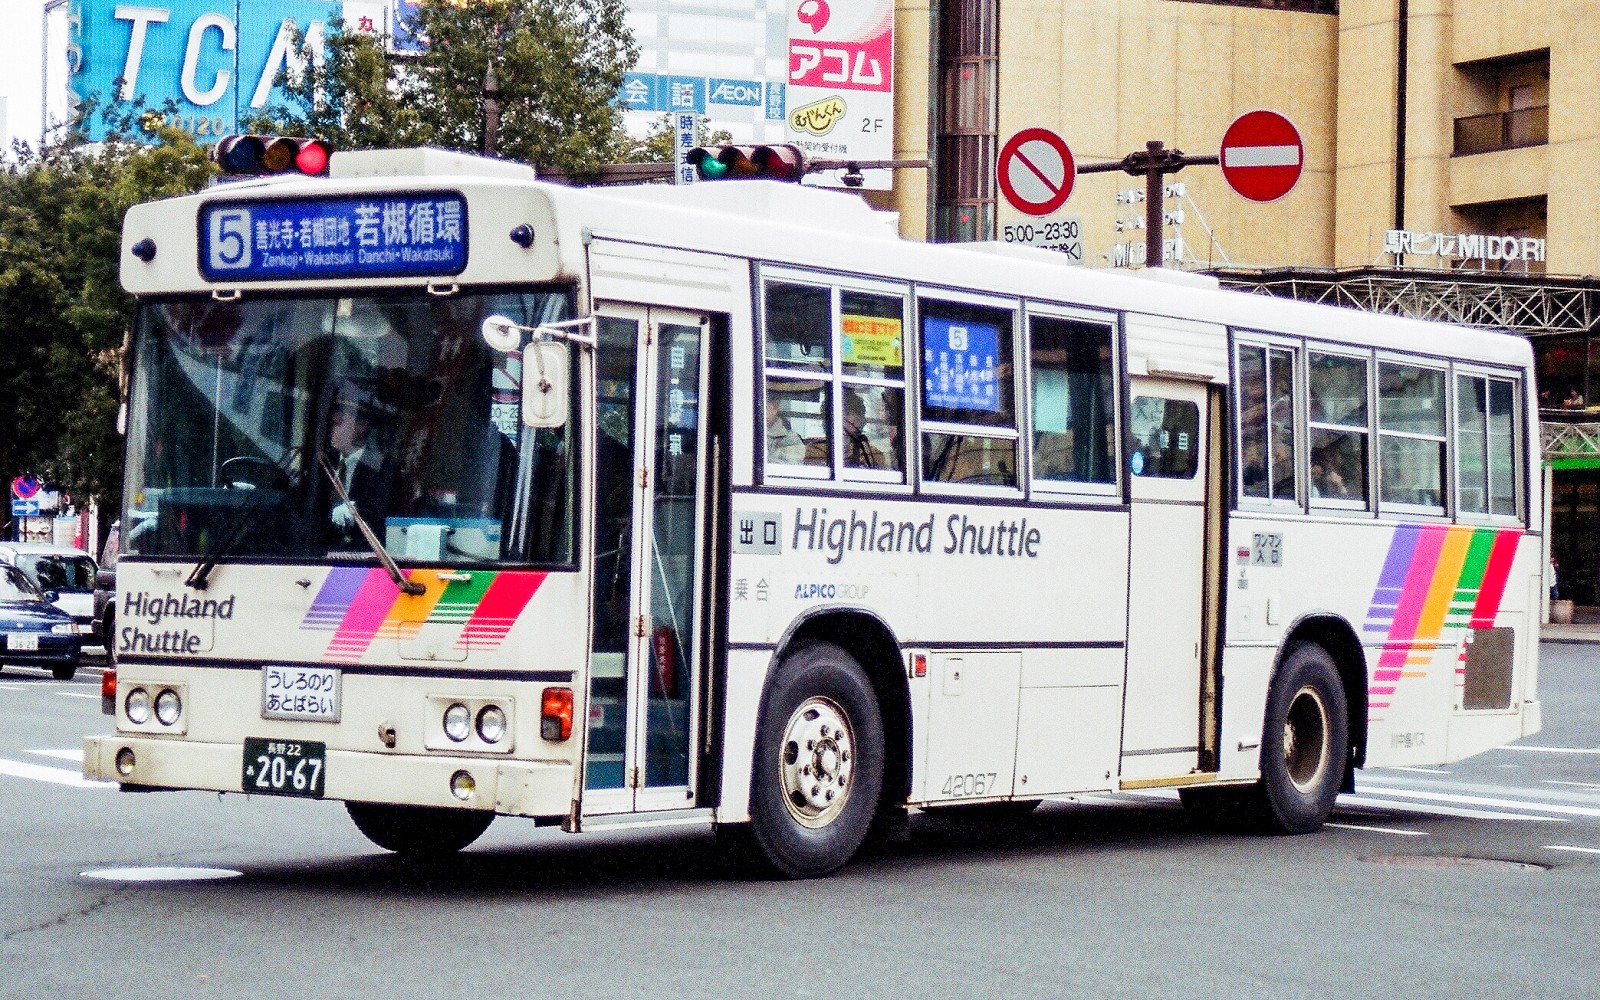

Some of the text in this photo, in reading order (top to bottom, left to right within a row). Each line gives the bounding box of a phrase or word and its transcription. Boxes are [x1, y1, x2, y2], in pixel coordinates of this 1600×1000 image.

[790, 46, 882, 85] アコム
[625, 79, 694, 107] 会話
[794, 101, 842, 130] むじんくん
[861, 117, 884, 133] 2F
[354, 200, 461, 248] 若槻循環
[218, 214, 245, 265] 5
[1458, 233, 1545, 262] MIDORI
[740, 519, 776, 545] 出口
[792, 507, 1041, 564] Highland Shuttle
[123, 592, 236, 625] Highland
[119, 626, 200, 654] Shuttle
[268, 671, 333, 692] うしろのり
[267, 694, 333, 714] あとばらい
[255, 755, 322, 791] 20-67
[941, 772, 998, 797] 42067
